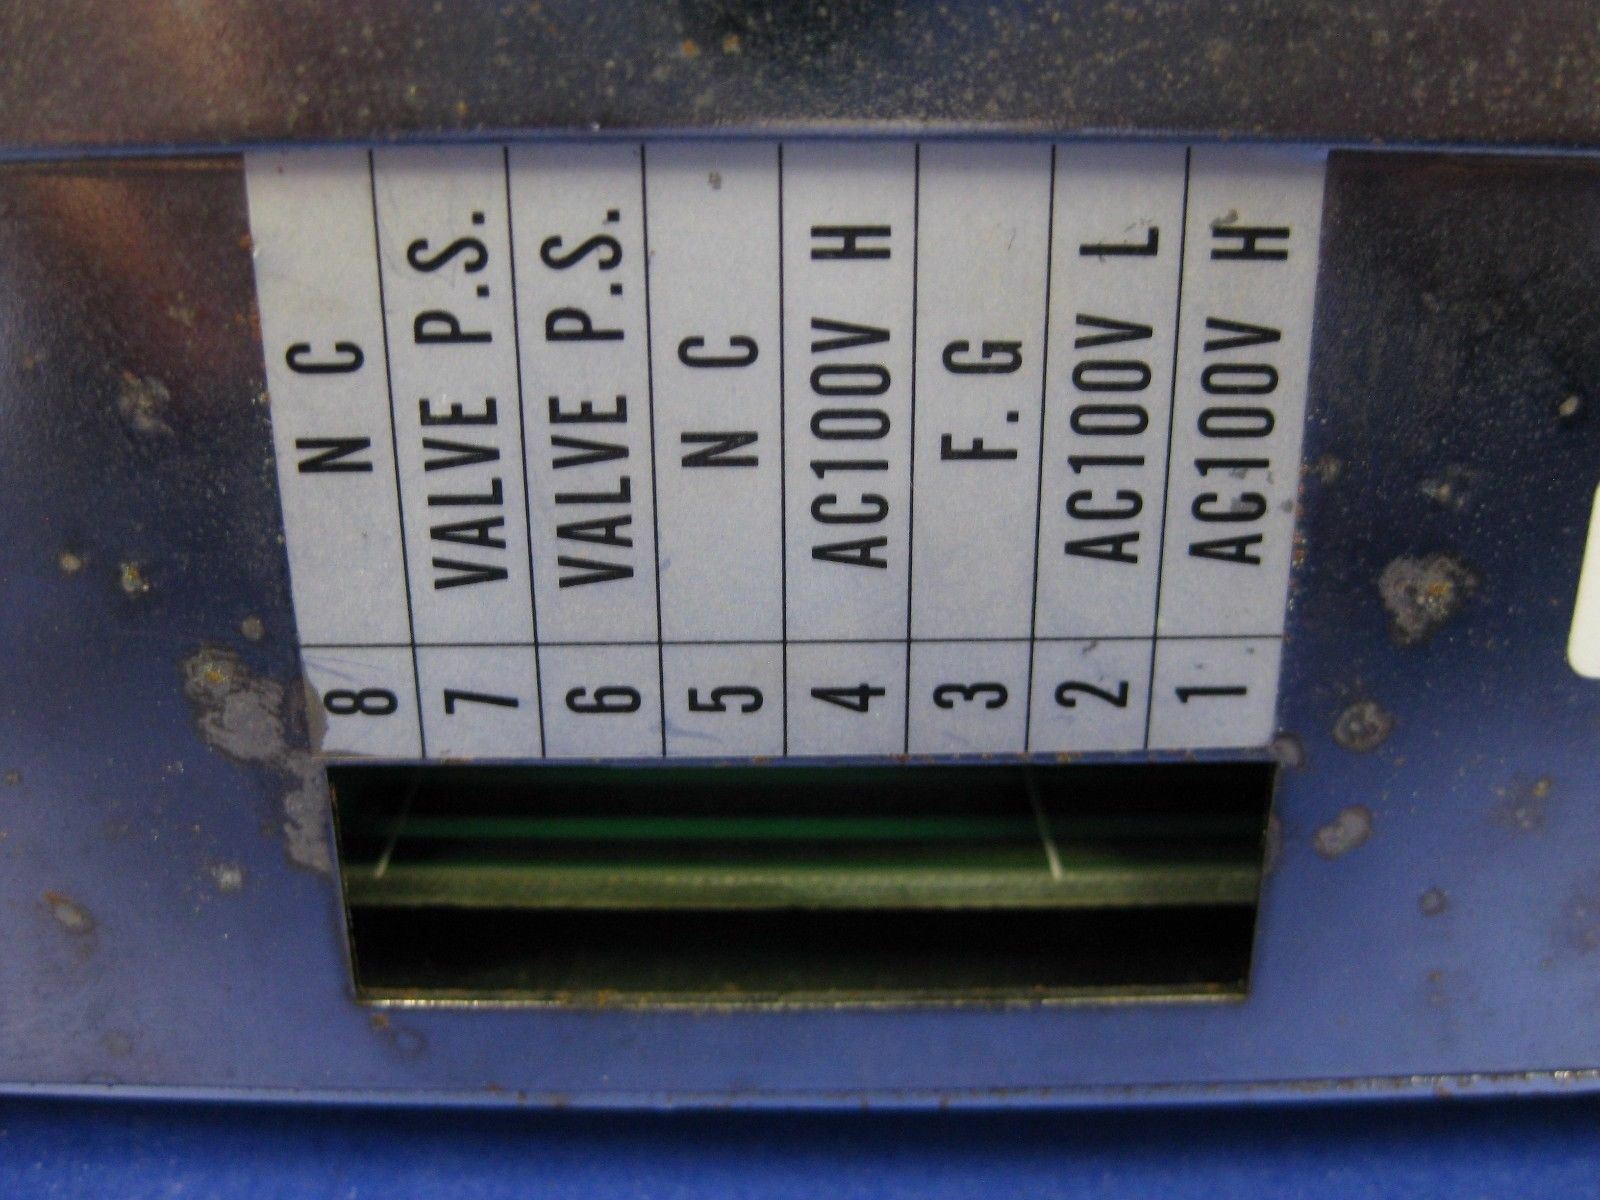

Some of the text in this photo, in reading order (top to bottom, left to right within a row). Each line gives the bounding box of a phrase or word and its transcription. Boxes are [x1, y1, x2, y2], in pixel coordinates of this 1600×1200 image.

[285, 341, 399, 716] 8 N C
[406, 209, 520, 715] 7 VALVE P.S.
[539, 208, 642, 714] 6 VALVE P.S.
[677, 334, 764, 714] 5 N C
[809, 225, 892, 713] 4 AC100V H
[932, 682, 1009, 710] 3
[1054, 226, 1160, 709] 2 AC100V L
[1174, 225, 1290, 704] 1 AC100V H
